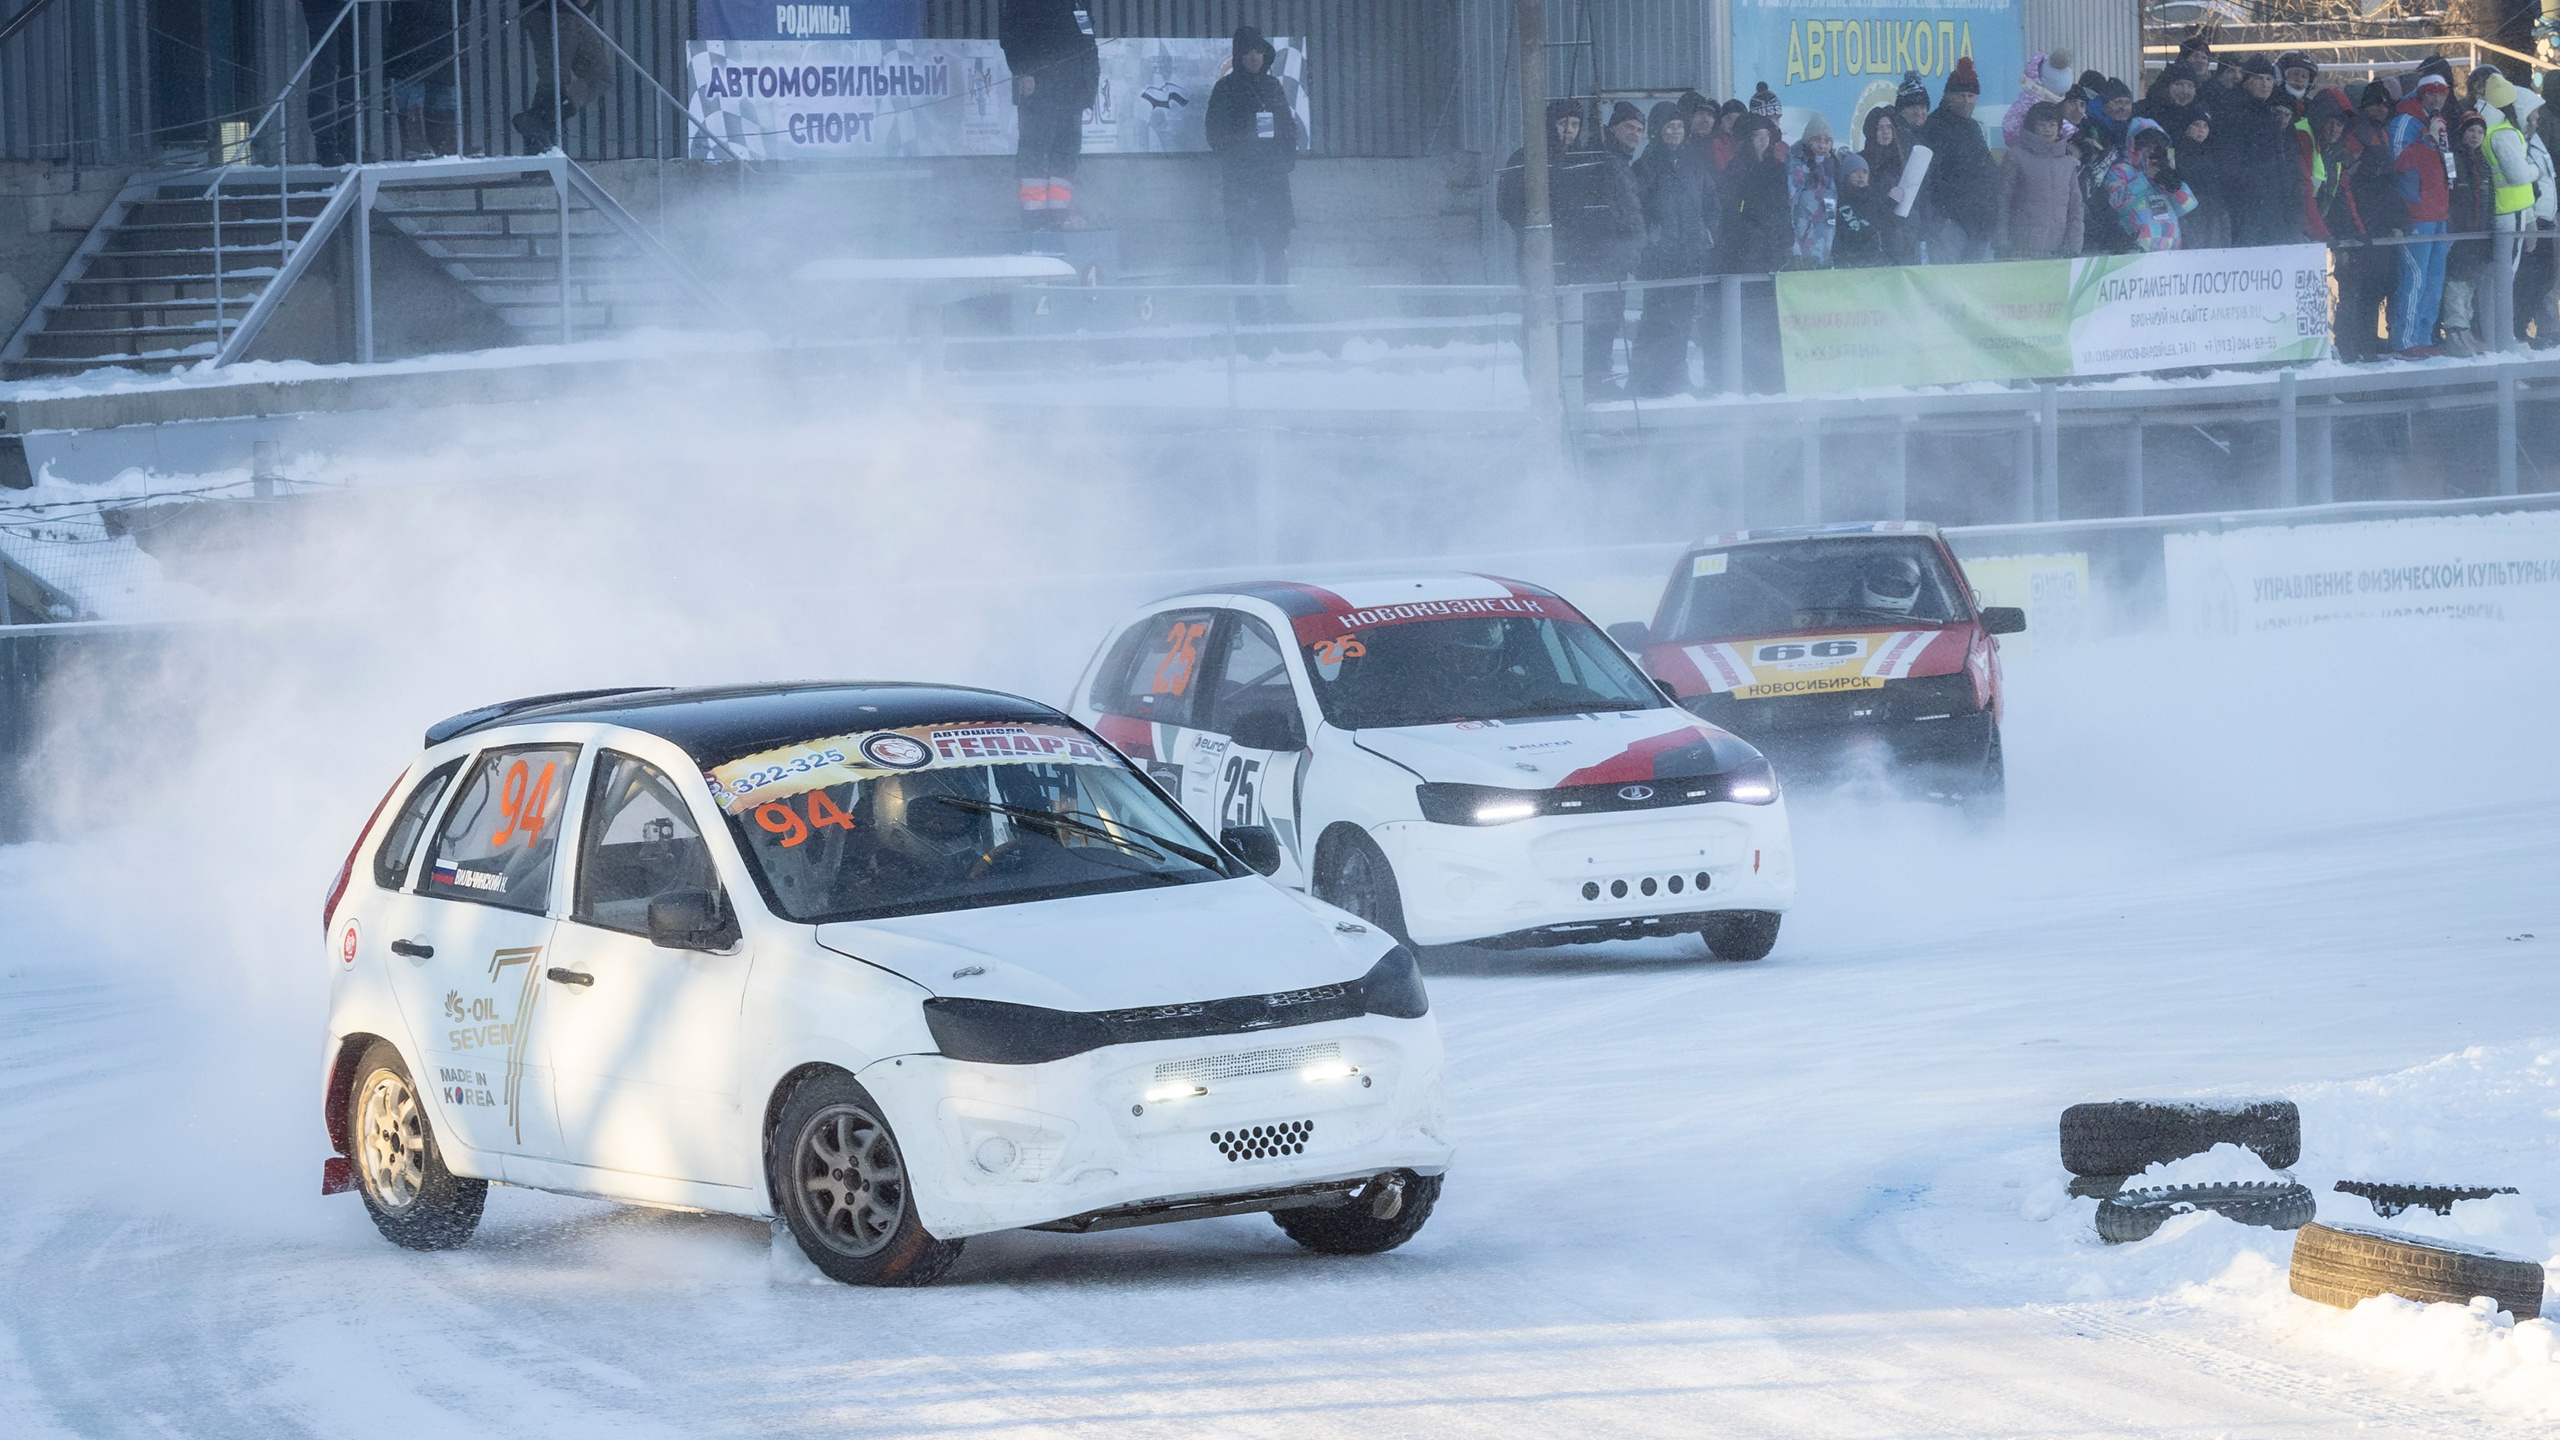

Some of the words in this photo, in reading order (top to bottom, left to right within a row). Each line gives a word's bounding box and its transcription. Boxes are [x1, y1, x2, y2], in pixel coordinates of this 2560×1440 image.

[776, 5, 851, 38] РОДИНЫ!
[1784, 18, 1975, 87] АВТОШКОЛА
[706, 55, 948, 98] АВТОМОБИЛЬНЫЙ
[788, 111, 875, 145] СПОРТ
[2099, 274, 2189, 302] АПАРТАМЕНТЫ
[2192, 268, 2283, 294] ПОСУТОЧНО
[2181, 303, 2209, 323] САЙТЕ
[2253, 570, 2353, 603] УПРАВЛЕНИЕ
[2358, 557, 2465, 594] ФИЗИЧЕСКОЙ
[2467, 559, 2548, 588] КУЛЬТУРЫ
[1338, 598, 1545, 629] НОВОКУЗНЕЦК
[1153, 621, 1208, 697] 25
[1313, 633, 1367, 666] 25
[1758, 640, 1858, 662] 66
[1749, 675, 1872, 697] НОВОСИБИРСК
[932, 726, 1026, 739] АВТОШКОЛА
[935, 735, 1104, 762] ГЕПАРД
[732, 748, 846, 794] 322-325
[491, 759, 555, 848] 94
[1221, 755, 1261, 827] 25
[753, 788, 856, 848] 94
[449, 1023, 515, 1051] SEVEN
[440, 1068, 472, 1085] MADE
[475, 1071, 488, 1087] IN
[443, 1086, 496, 1107] KOREA
